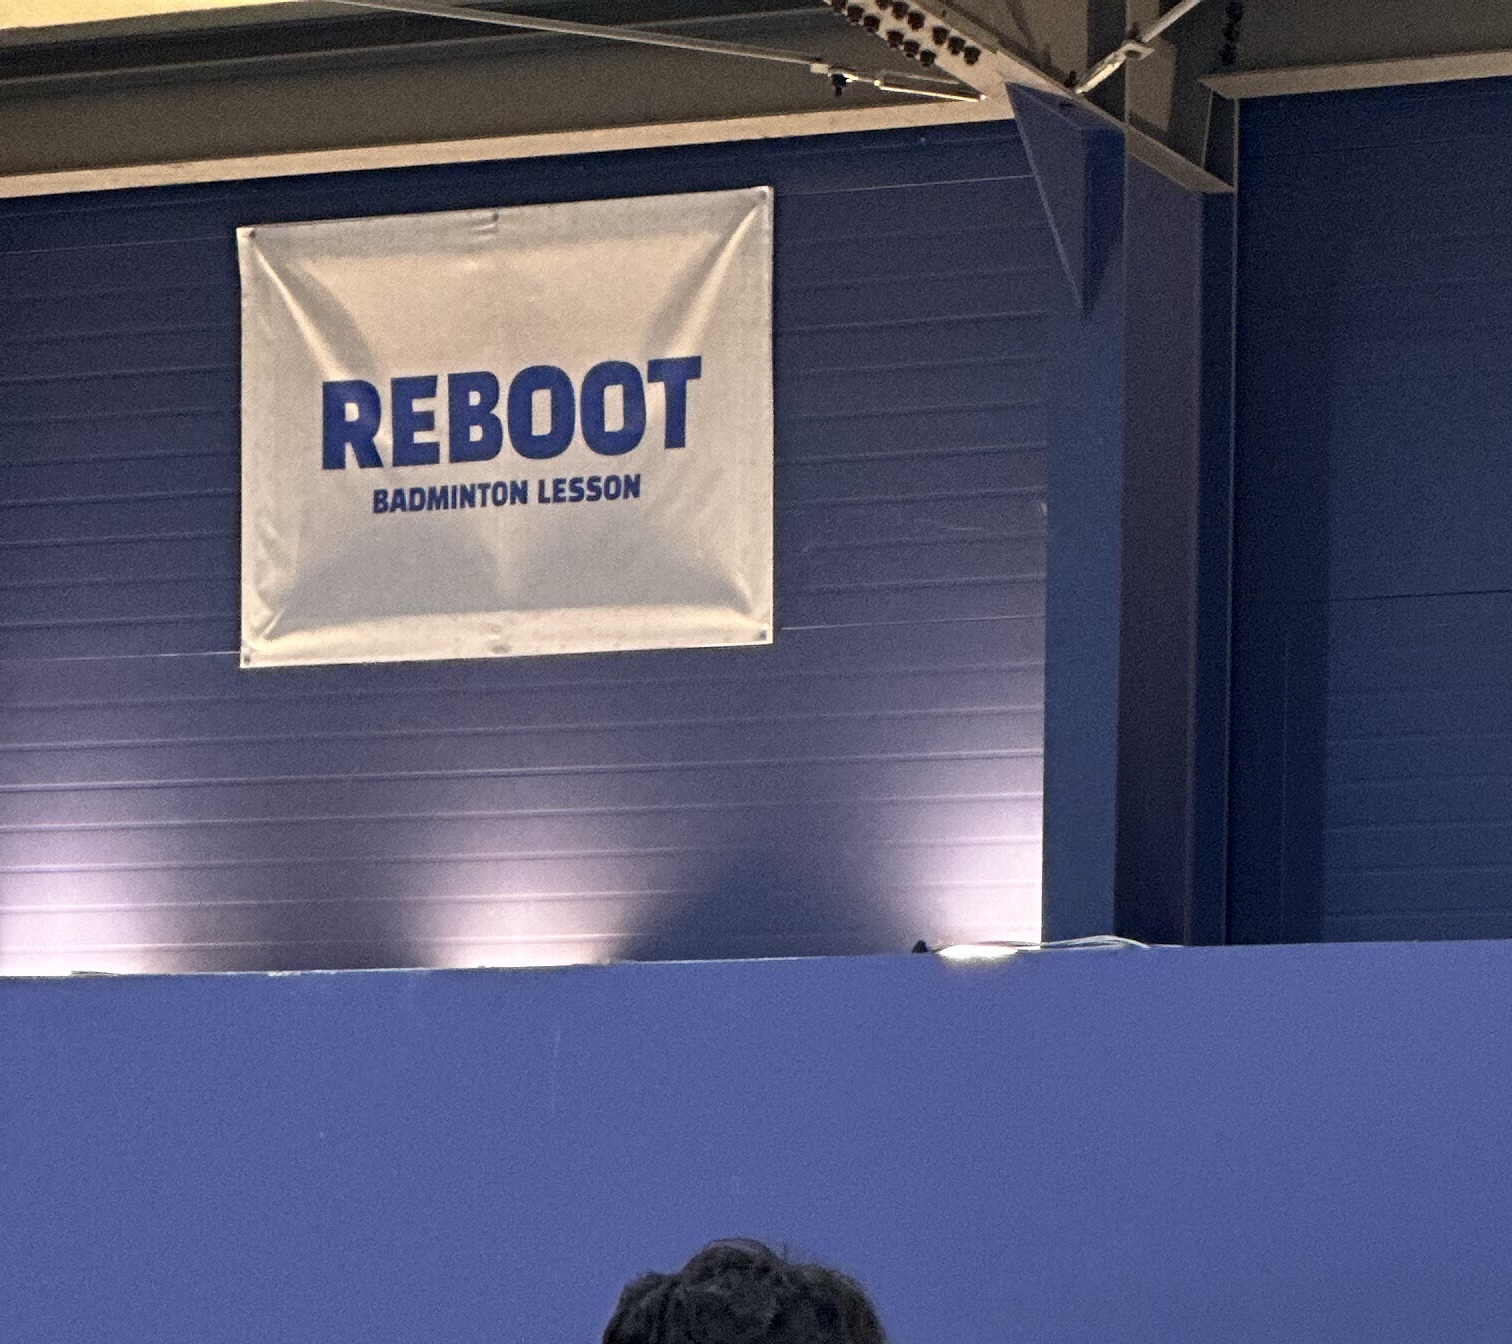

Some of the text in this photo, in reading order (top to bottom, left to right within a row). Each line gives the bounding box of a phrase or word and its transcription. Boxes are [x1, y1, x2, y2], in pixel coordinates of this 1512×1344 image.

[322, 356, 702, 470] REBOOT
[372, 474, 642, 515] BADMINTON LESSON
